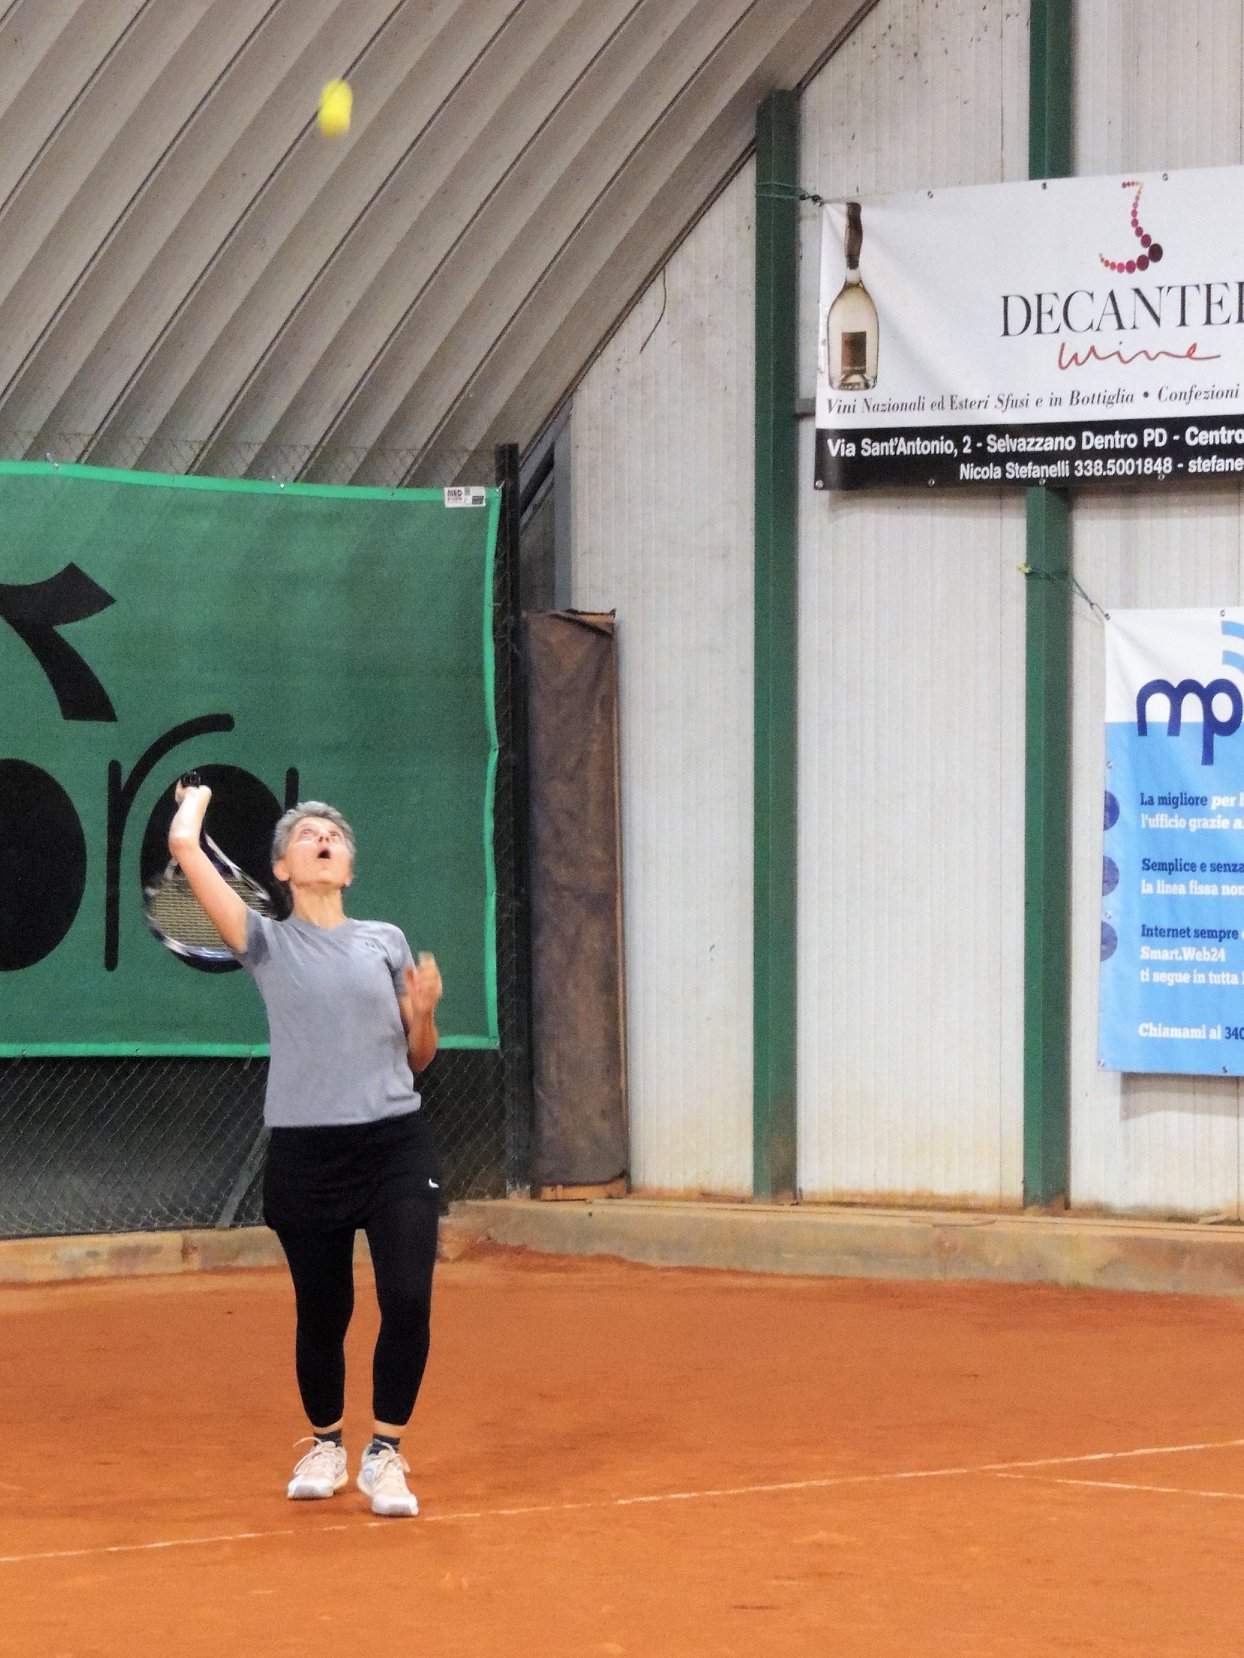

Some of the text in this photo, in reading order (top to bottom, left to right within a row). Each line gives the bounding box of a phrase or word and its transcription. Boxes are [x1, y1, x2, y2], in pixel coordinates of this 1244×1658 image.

[1058, 341, 1221, 370] wine
[827, 383, 1240, 415] Vini Nazionali ed Esteri Sfusi e in Bottiglia Confezioni
[827, 438, 856, 458] Via
[860, 435, 958, 458] Sant'Antonio,
[962, 435, 972, 454] 2
[987, 431, 1076, 454] Selvazzano
[1081, 429, 1138, 451] Dentro
[1143, 427, 1168, 449] PD
[1185, 425, 1244, 446] Centro
[959, 462, 1001, 480] Nicola
[1006, 459, 1069, 480] Stefanelli
[1074, 456, 1173, 478] 338.5001848
[1140, 792, 1154, 806] La
[1158, 792, 1208, 809] migliore
[1211, 795, 1236, 810] per
[1141, 813, 1187, 829] l'ufficio
[1189, 814, 1230, 832] grazie
[1141, 858, 1244, 875] Semplice e senza
[1141, 880, 1153, 895] la
[1156, 880, 1187, 895] linea
[1190, 879, 1218, 895] fissa
[1141, 924, 1191, 939] Internet
[1193, 928, 1239, 942] sempre
[1140, 946, 1226, 962] Smart.Web24
[1140, 968, 1149, 982] ti
[1152, 972, 1190, 986] segue
[1193, 969, 1205, 984] in
[1208, 971, 1239, 985] tutta
[1138, 1022, 1206, 1039] Chiamami
[1209, 1025, 1221, 1040] al
